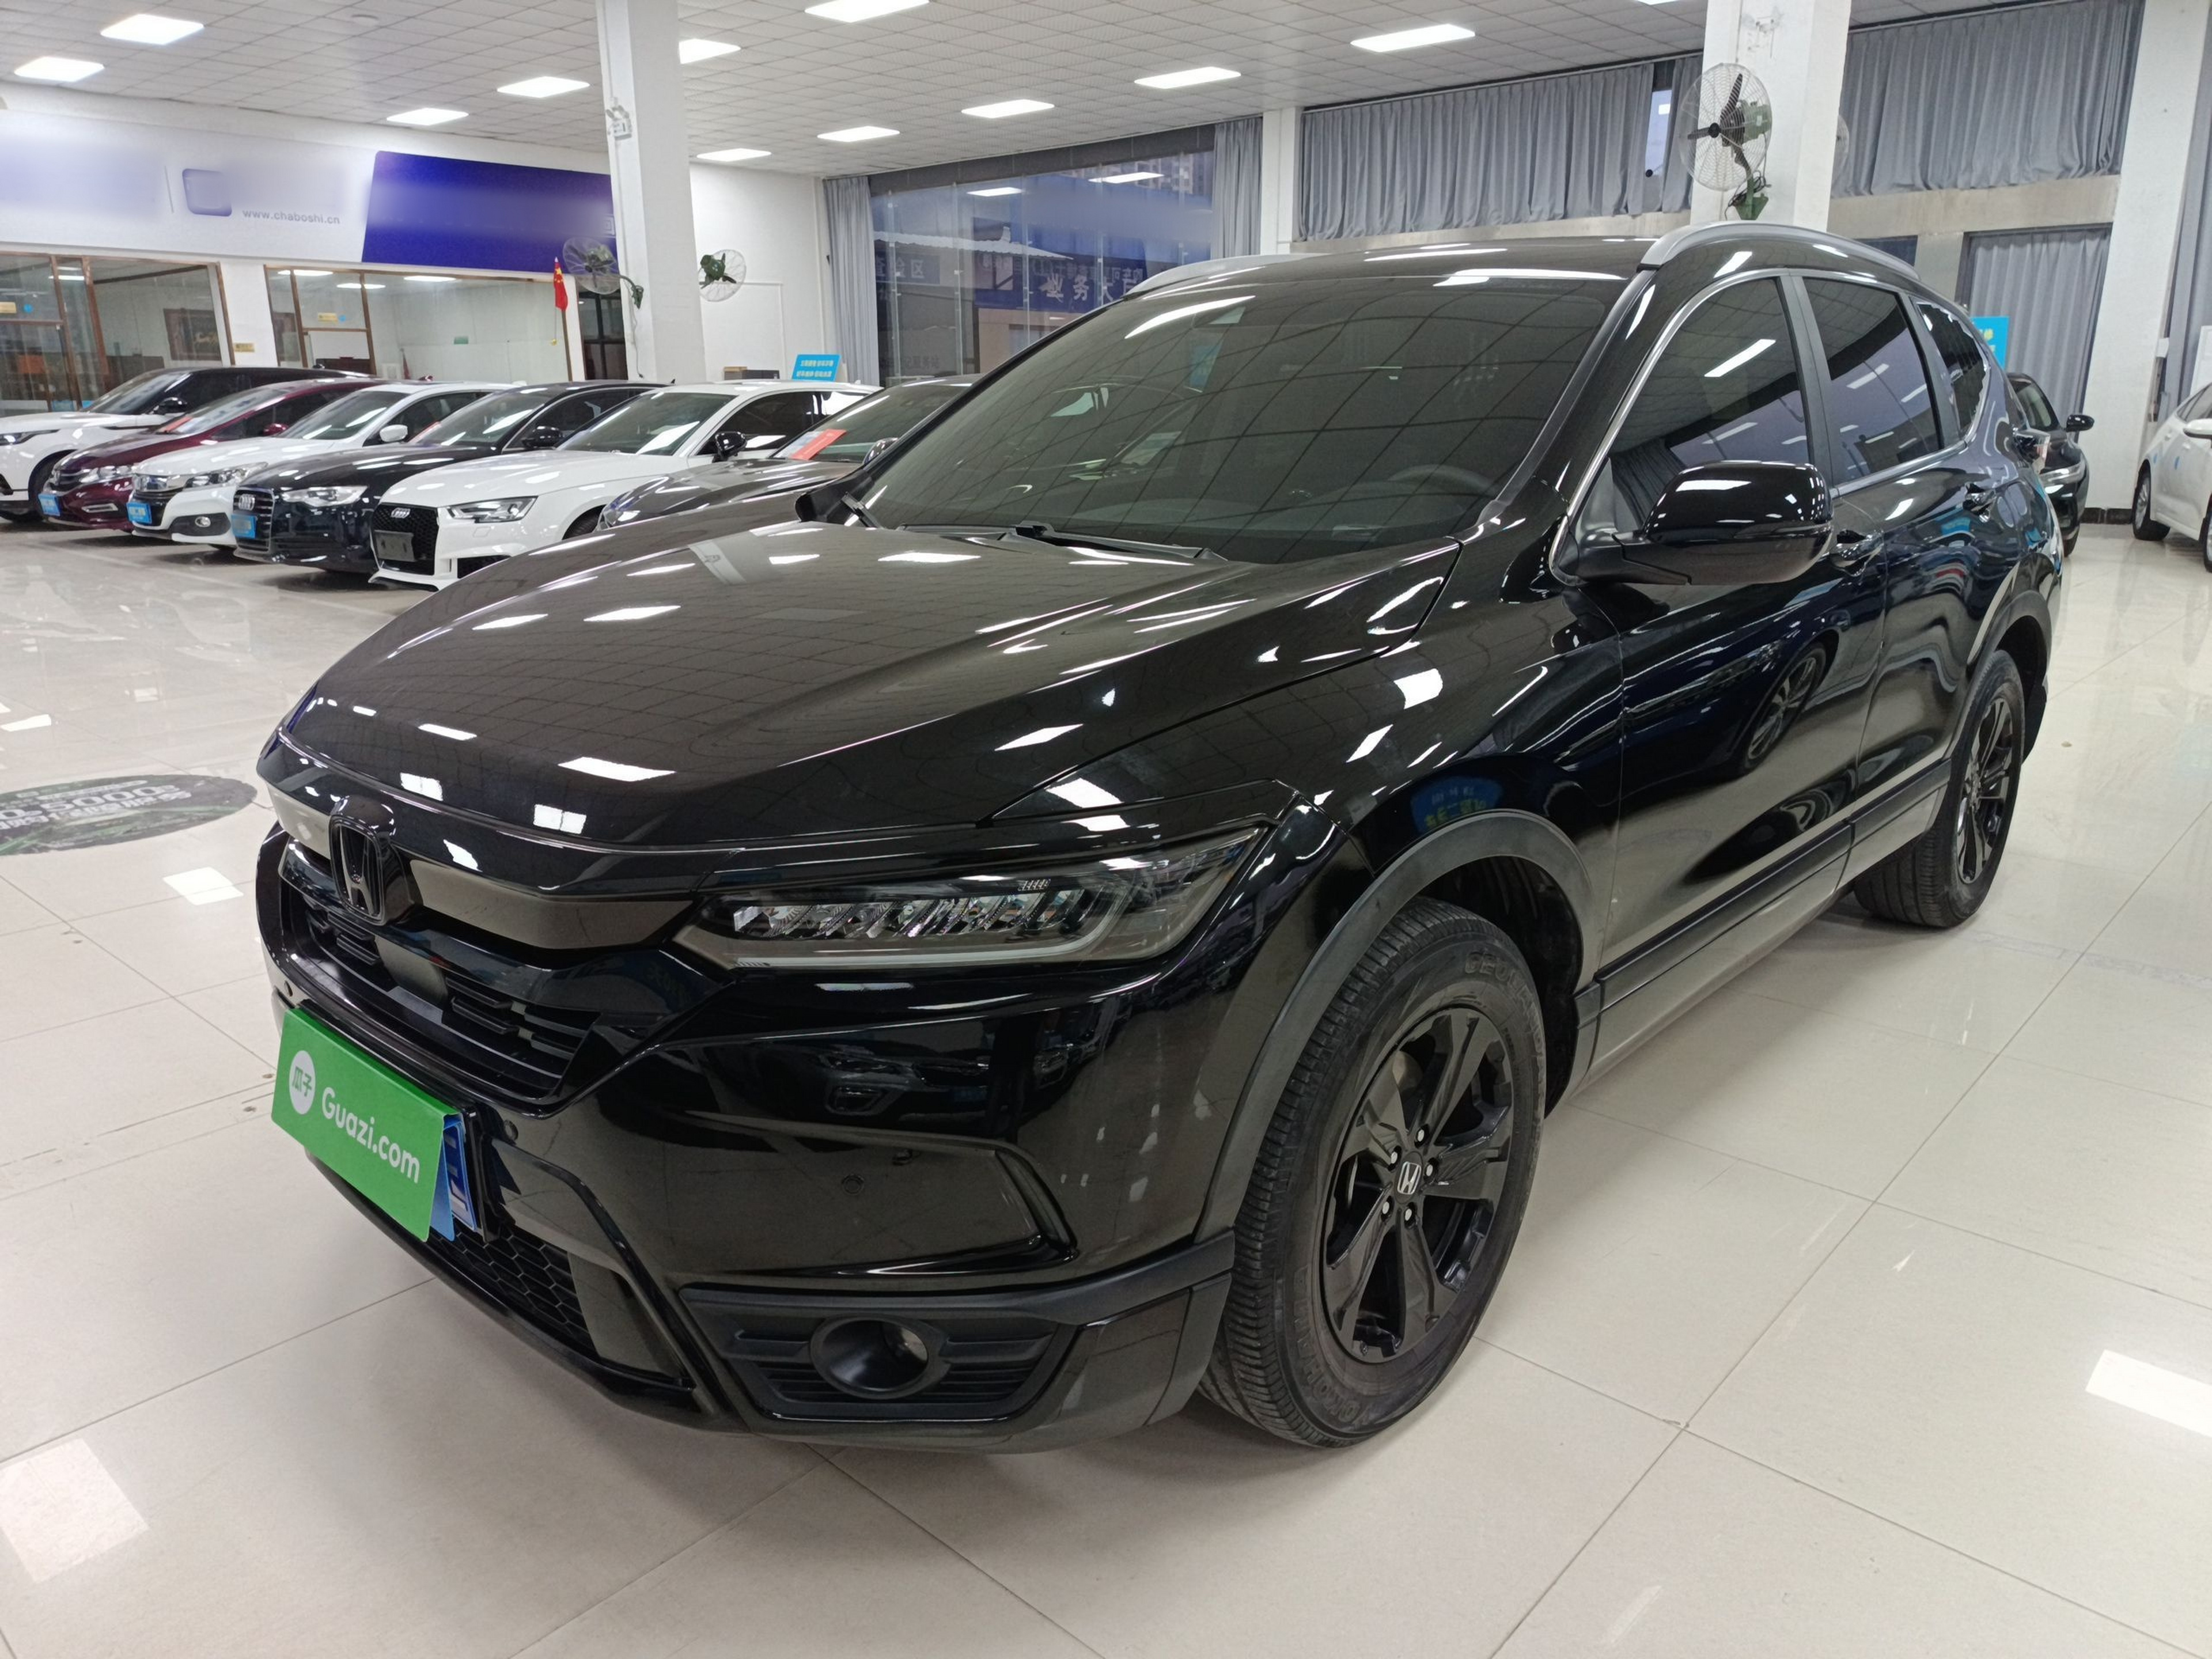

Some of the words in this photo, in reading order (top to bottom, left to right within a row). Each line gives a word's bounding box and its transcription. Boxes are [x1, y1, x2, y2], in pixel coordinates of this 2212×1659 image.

[242, 210, 340, 225] www.chaboshi.cn
[291, 1066, 312, 1097] 瓜子
[321, 1086, 421, 1184] Guazi.com
